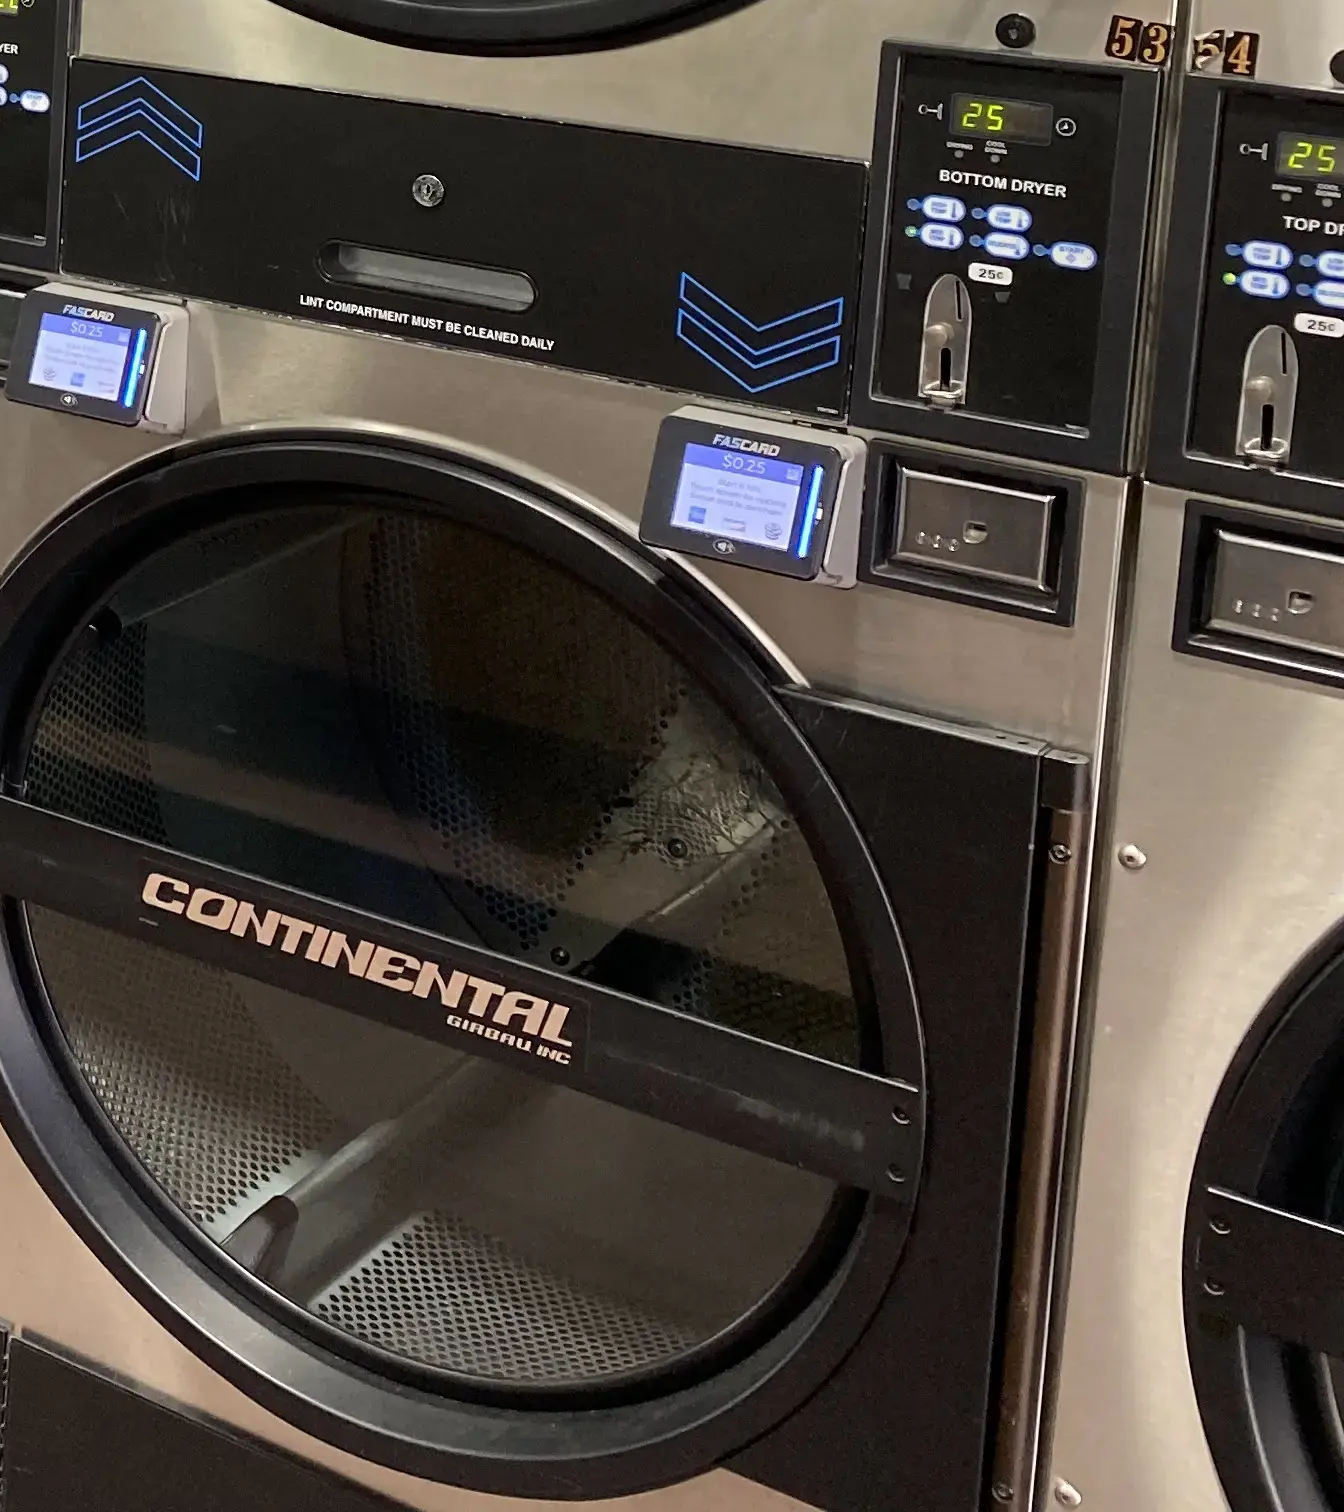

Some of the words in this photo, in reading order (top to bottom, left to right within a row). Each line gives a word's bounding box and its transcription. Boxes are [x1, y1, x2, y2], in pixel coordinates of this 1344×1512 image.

[1111, 19, 1169, 65] 53
[1194, 31, 1252, 75] 54
[962, 102, 1004, 131] 25
[1288, 142, 1336, 173] 25
[939, 169, 1007, 190] BOTTOM
[1011, 178, 1067, 198] DRYER
[1282, 215, 1320, 232] TOP
[63, 304, 115, 322] FASCARD
[300, 294, 324, 308] LINT
[325, 299, 409, 326] COMPARTMENT
[412, 315, 443, 331] MUST
[446, 322, 461, 335] BE
[464, 325, 518, 345] CLEANED
[521, 335, 555, 351] DAILY
[712, 433, 781, 457] FASCARD
[141, 872, 573, 1048] CONTINENTAL
